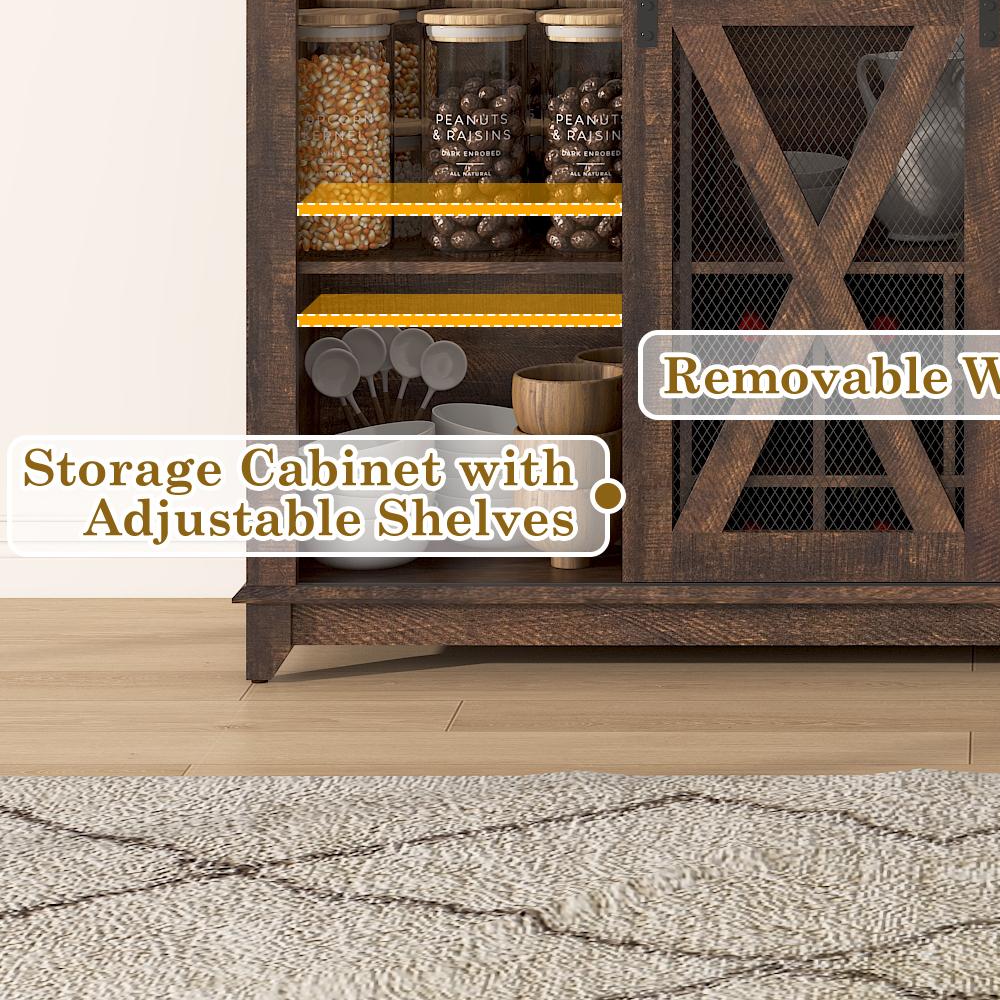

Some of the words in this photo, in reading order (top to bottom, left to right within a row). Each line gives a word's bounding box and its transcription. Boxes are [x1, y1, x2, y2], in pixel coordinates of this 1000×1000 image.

[436, 114, 509, 126] PEANUTS
[432, 130, 441, 141] &
[447, 130, 511, 141] RAISINS
[553, 130, 561, 141] &
[567, 130, 622, 141] RAISIN
